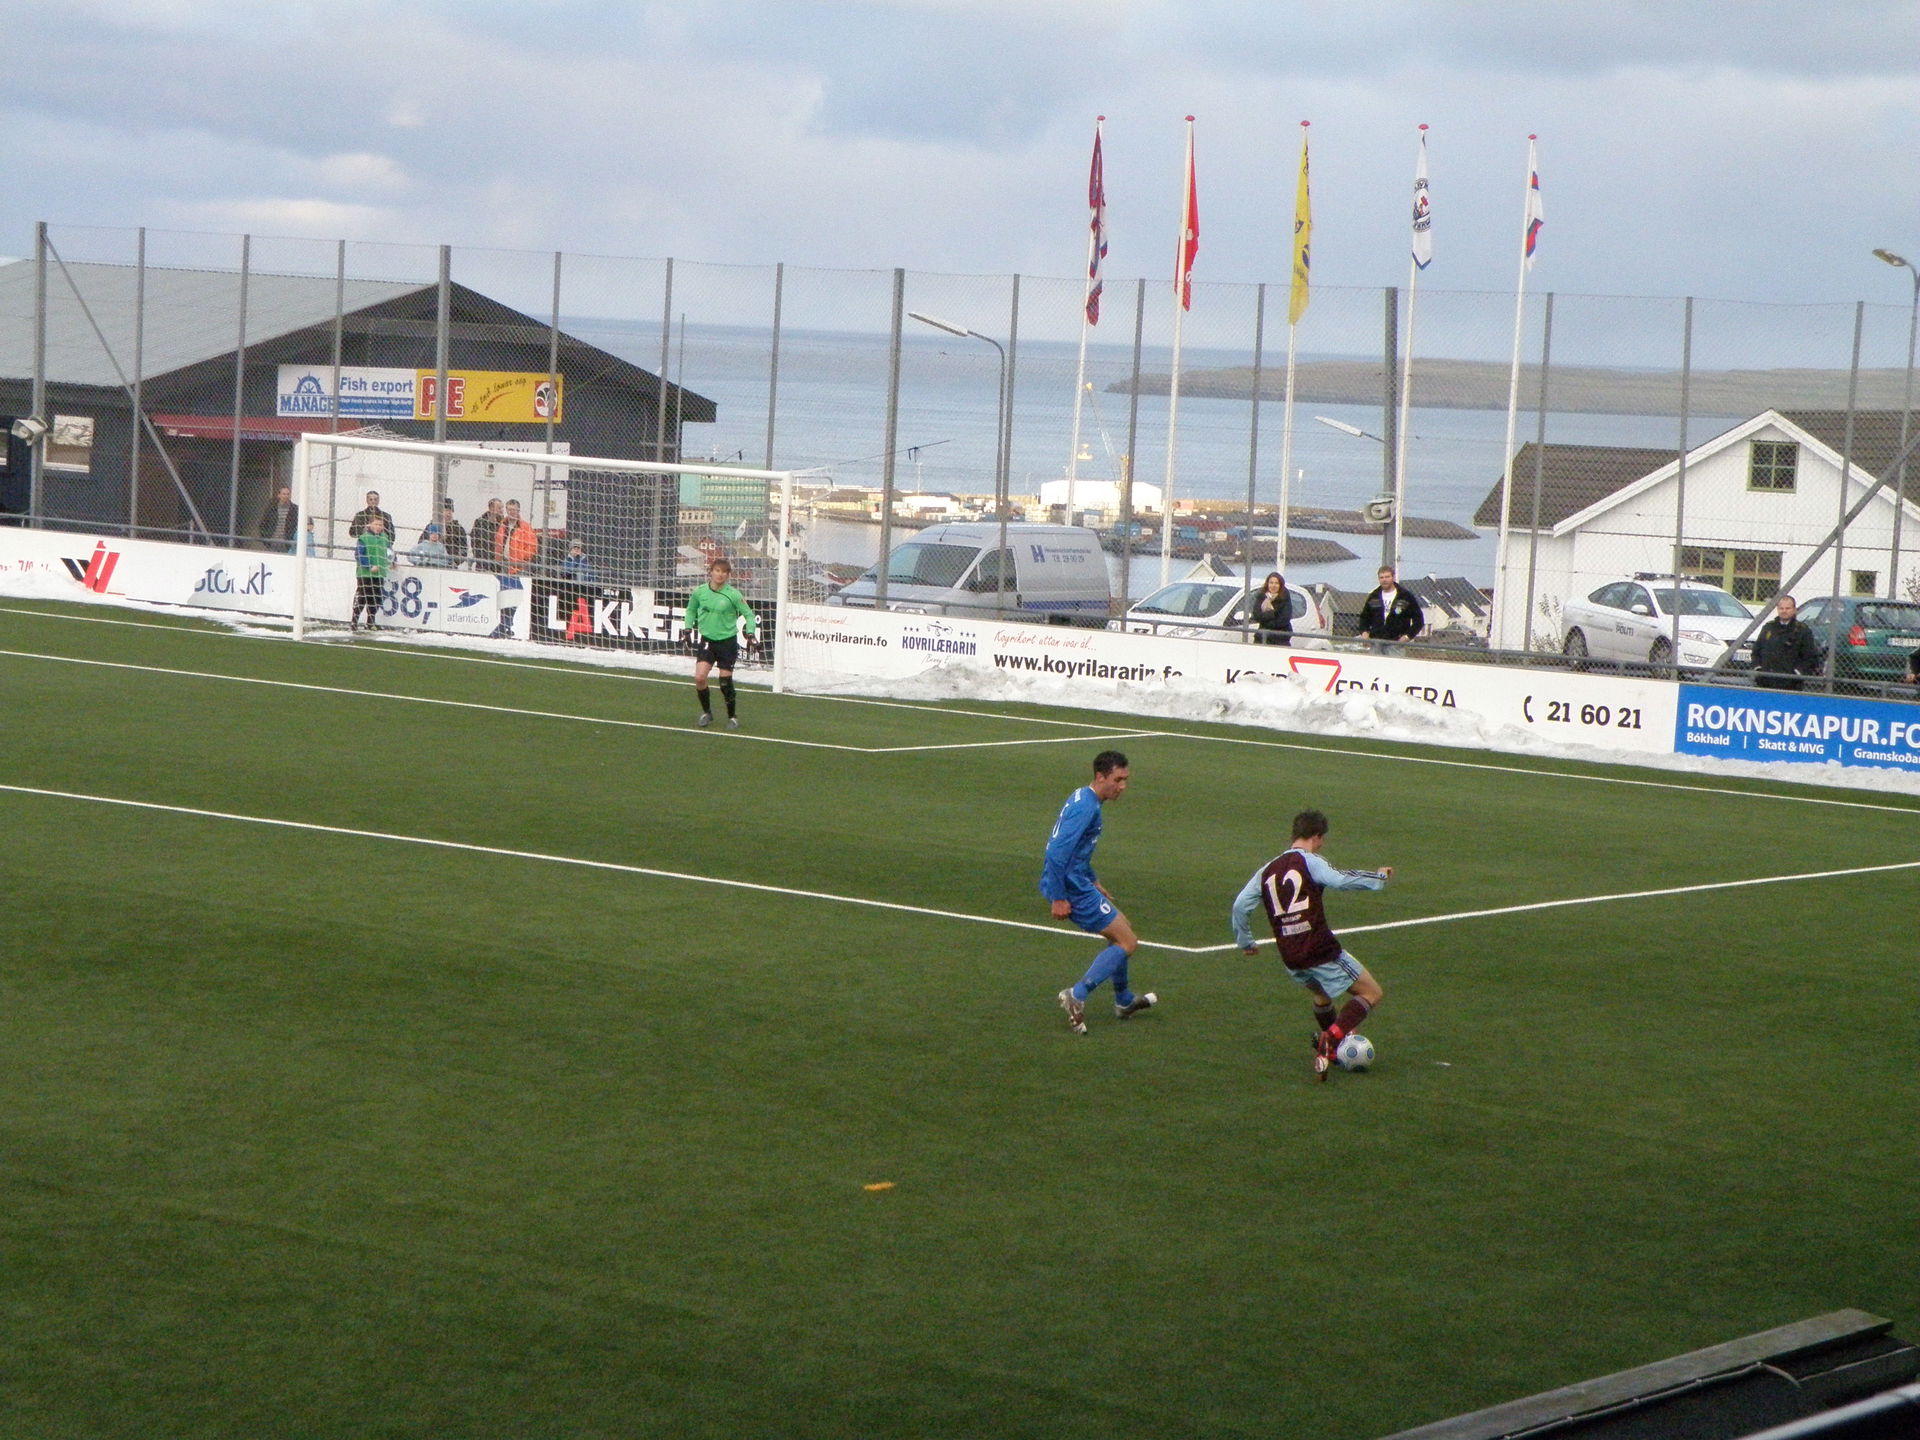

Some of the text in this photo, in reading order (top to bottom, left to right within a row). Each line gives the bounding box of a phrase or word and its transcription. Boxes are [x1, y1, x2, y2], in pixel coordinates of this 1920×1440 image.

[340, 377, 413, 395] Fish export
[446, 612, 489, 625] atlantic.fo
[902, 636, 976, 656] KOYRILÆRARIN
[1547, 701, 1641, 729] 21 60 21
[1687, 731, 1920, 764] Bókhald Skatt & MVG Grannskoða
[1265, 869, 1309, 917] 12
